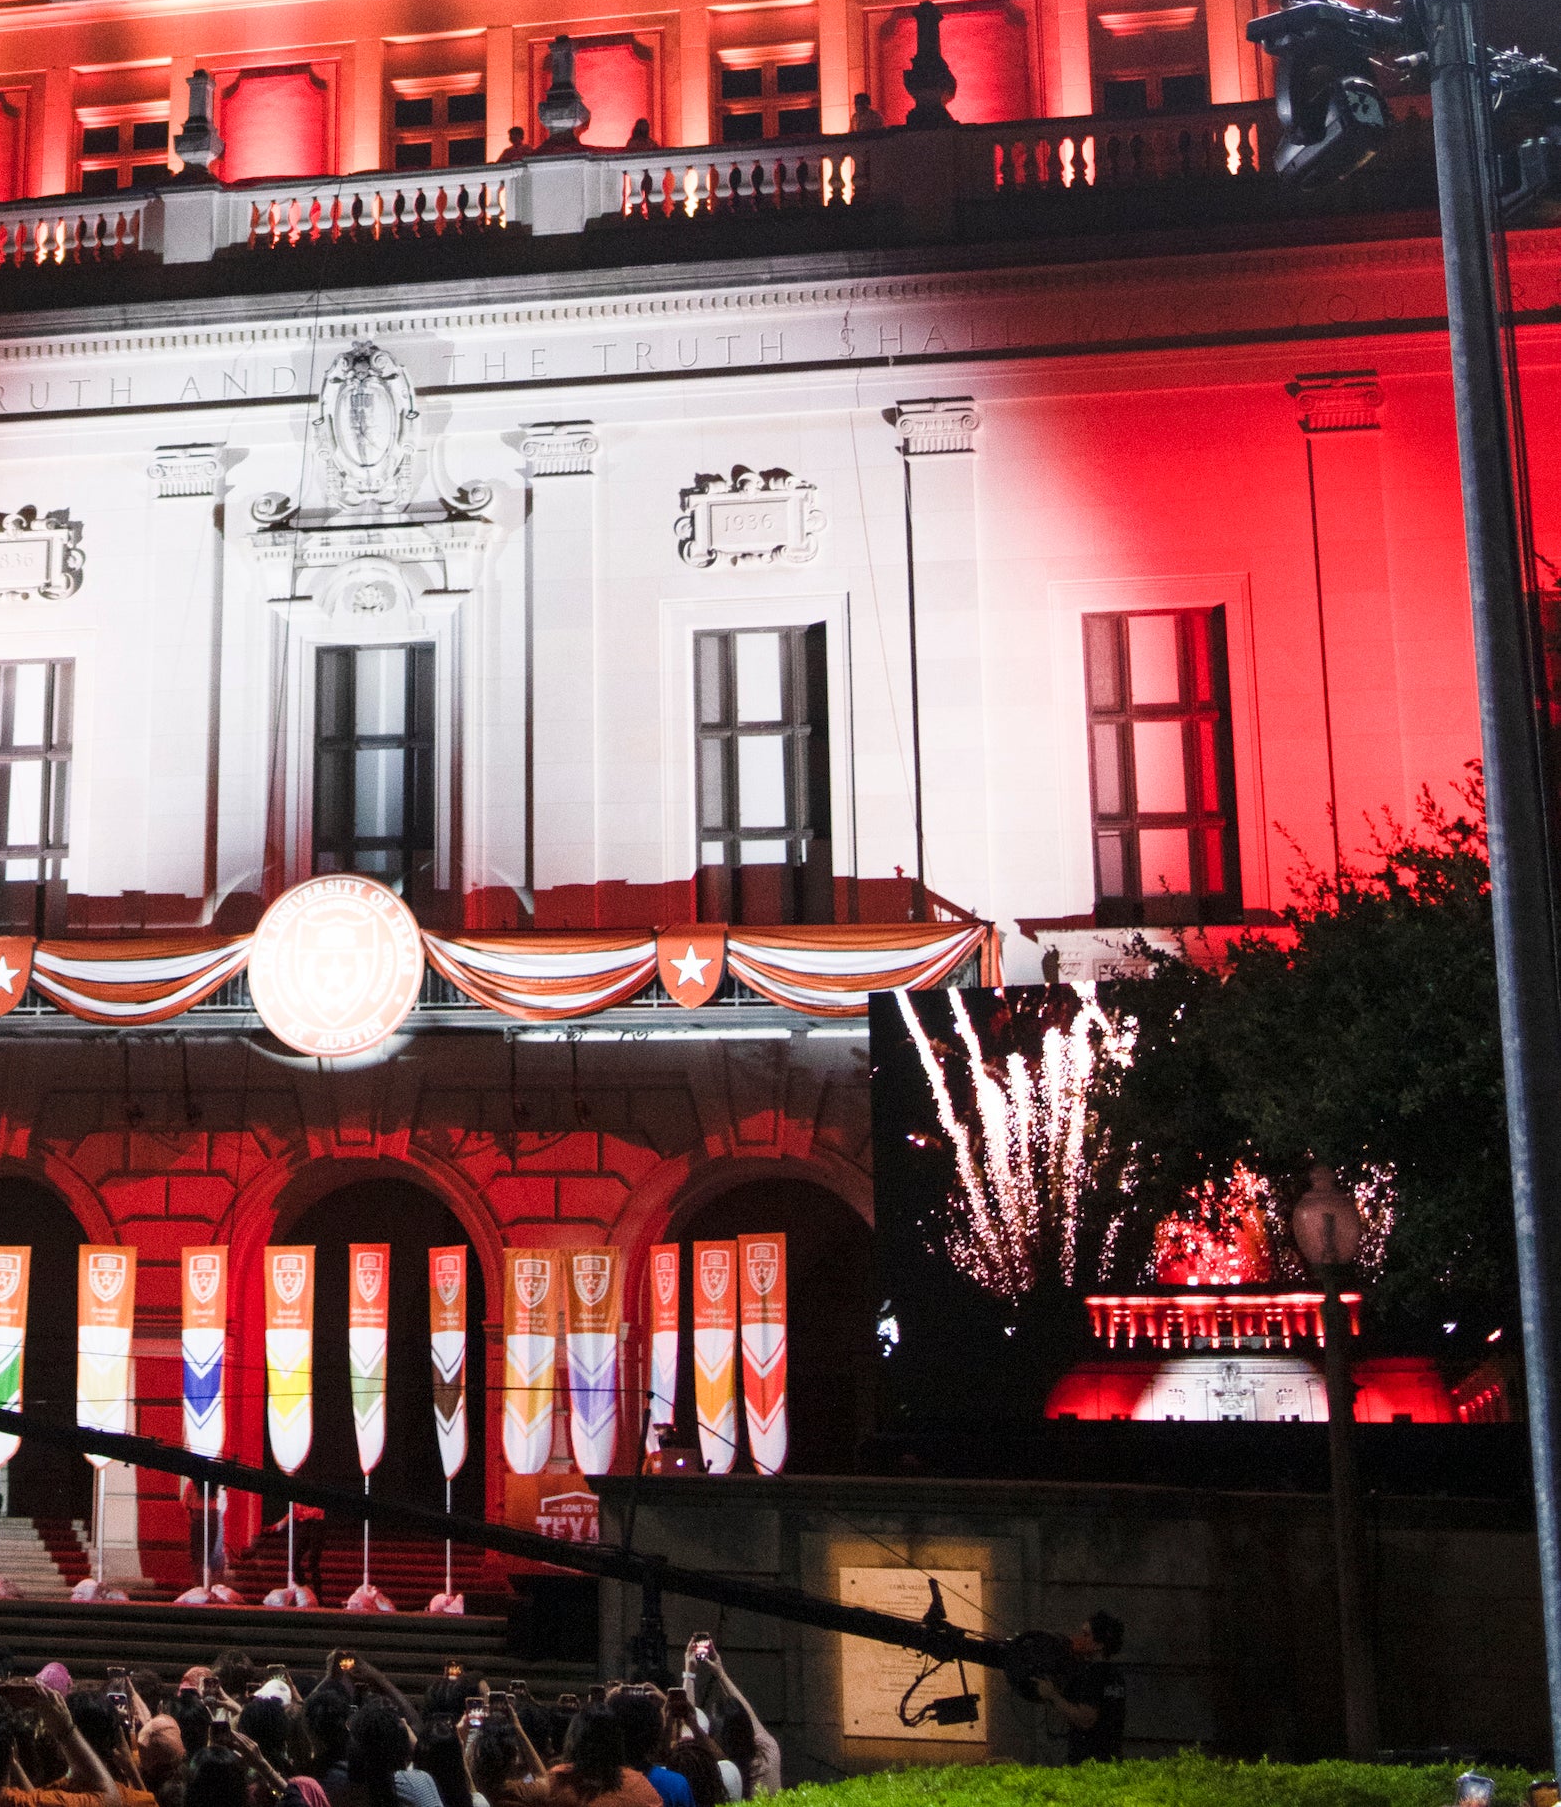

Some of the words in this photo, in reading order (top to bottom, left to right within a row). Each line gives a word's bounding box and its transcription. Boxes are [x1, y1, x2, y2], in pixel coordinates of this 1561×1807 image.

[180, 365, 297, 401] AND
[442, 347, 548, 383] THE
[593, 331, 784, 373] TRUTH
[838, 317, 1023, 358] SHALL
[724, 513, 774, 532] 1936
[271, 879, 366, 932] UNIVERSITY
[369, 890, 394, 913] OF
[391, 910, 415, 976] TEXAS
[283, 1022, 306, 1042] AT
[315, 1017, 385, 1049] AUSTIN
[560, 1504, 581, 1513] GONE
[583, 1504, 594, 1513] TO
[536, 1515, 599, 1543] TEXA
